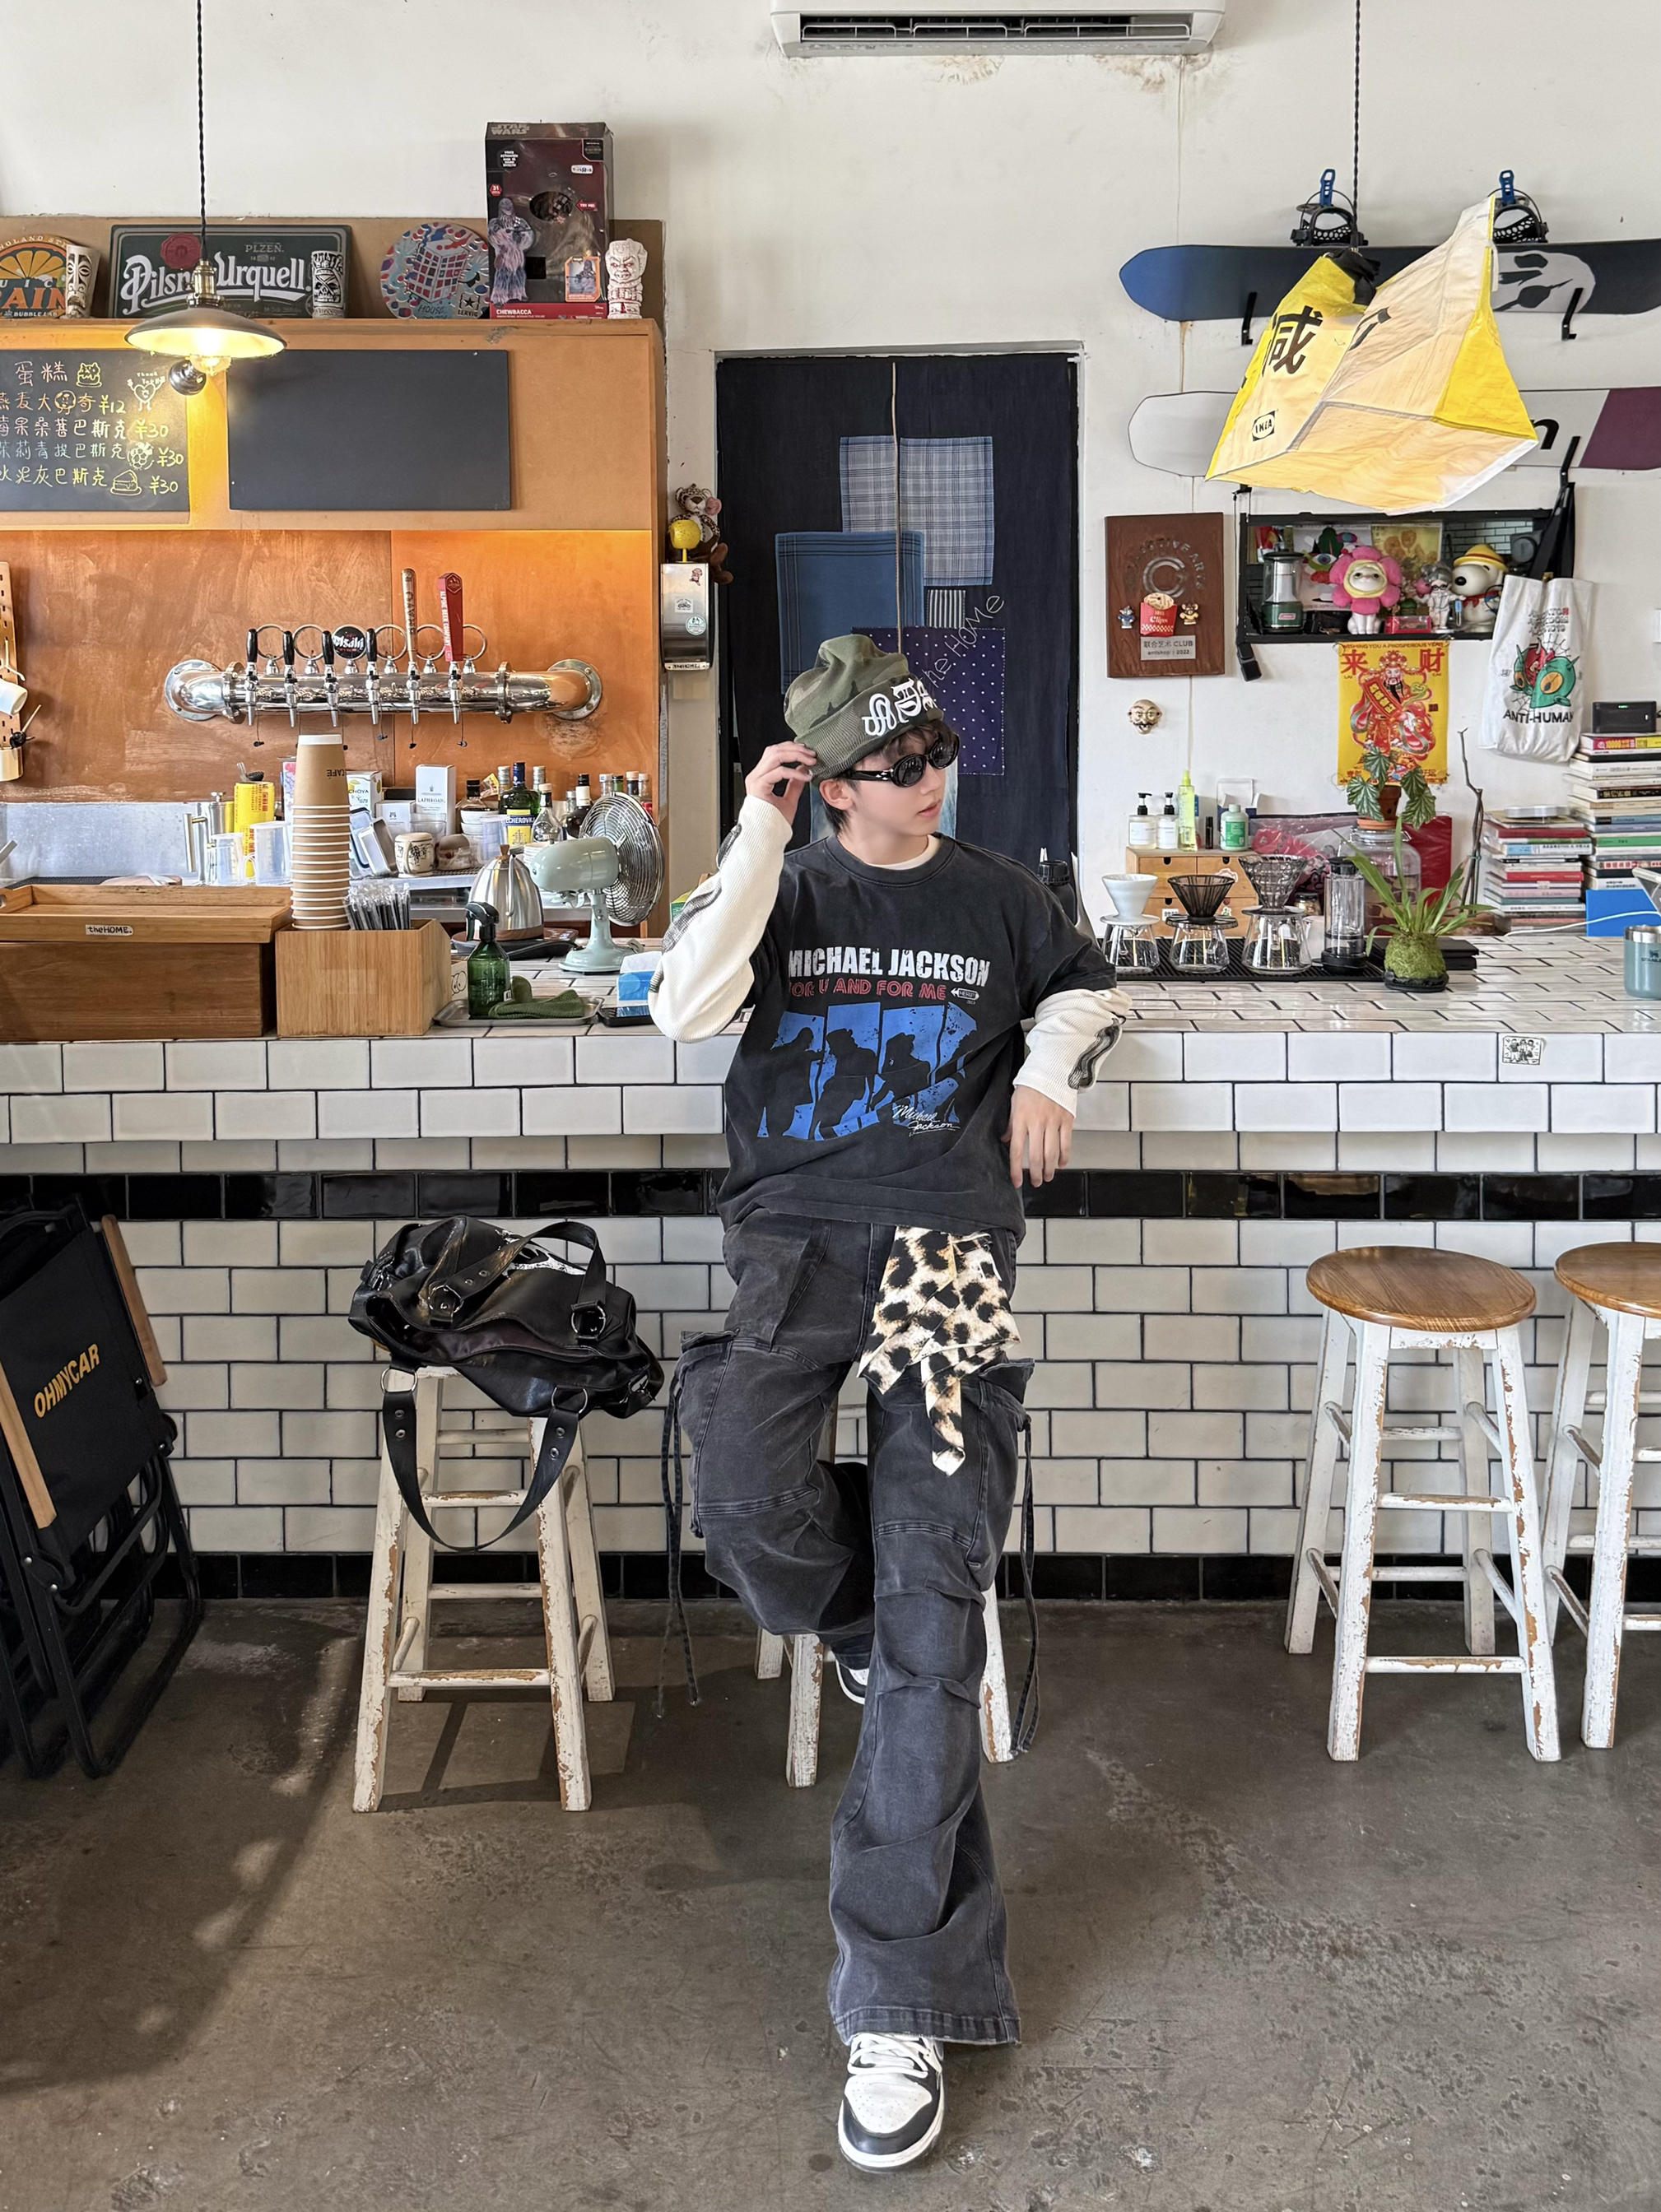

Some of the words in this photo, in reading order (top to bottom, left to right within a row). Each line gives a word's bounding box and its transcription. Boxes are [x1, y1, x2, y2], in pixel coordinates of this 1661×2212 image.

[15, 360, 67, 386] 蛋糕
[99, 394, 126, 415] ¥12
[135, 419, 169, 439] ¥30
[1255, 419, 1272, 434] IKEA
[157, 447, 184, 467] ¥30
[149, 476, 179, 495] ¥30
[333, 635, 364, 650] Asahi
[1341, 649, 1368, 676] 来
[1420, 648, 1445, 673] 财
[87, 926, 133, 934] theHOME.
[789, 946, 882, 978] MICHAEL
[888, 948, 990, 987] JACKSON
[789, 982, 814, 997] OR
[833, 978, 872, 995] AND
[876, 980, 913, 997] FOR
[919, 983, 947, 1001] ME
[34, 1344, 100, 1418] OHMYCAR
